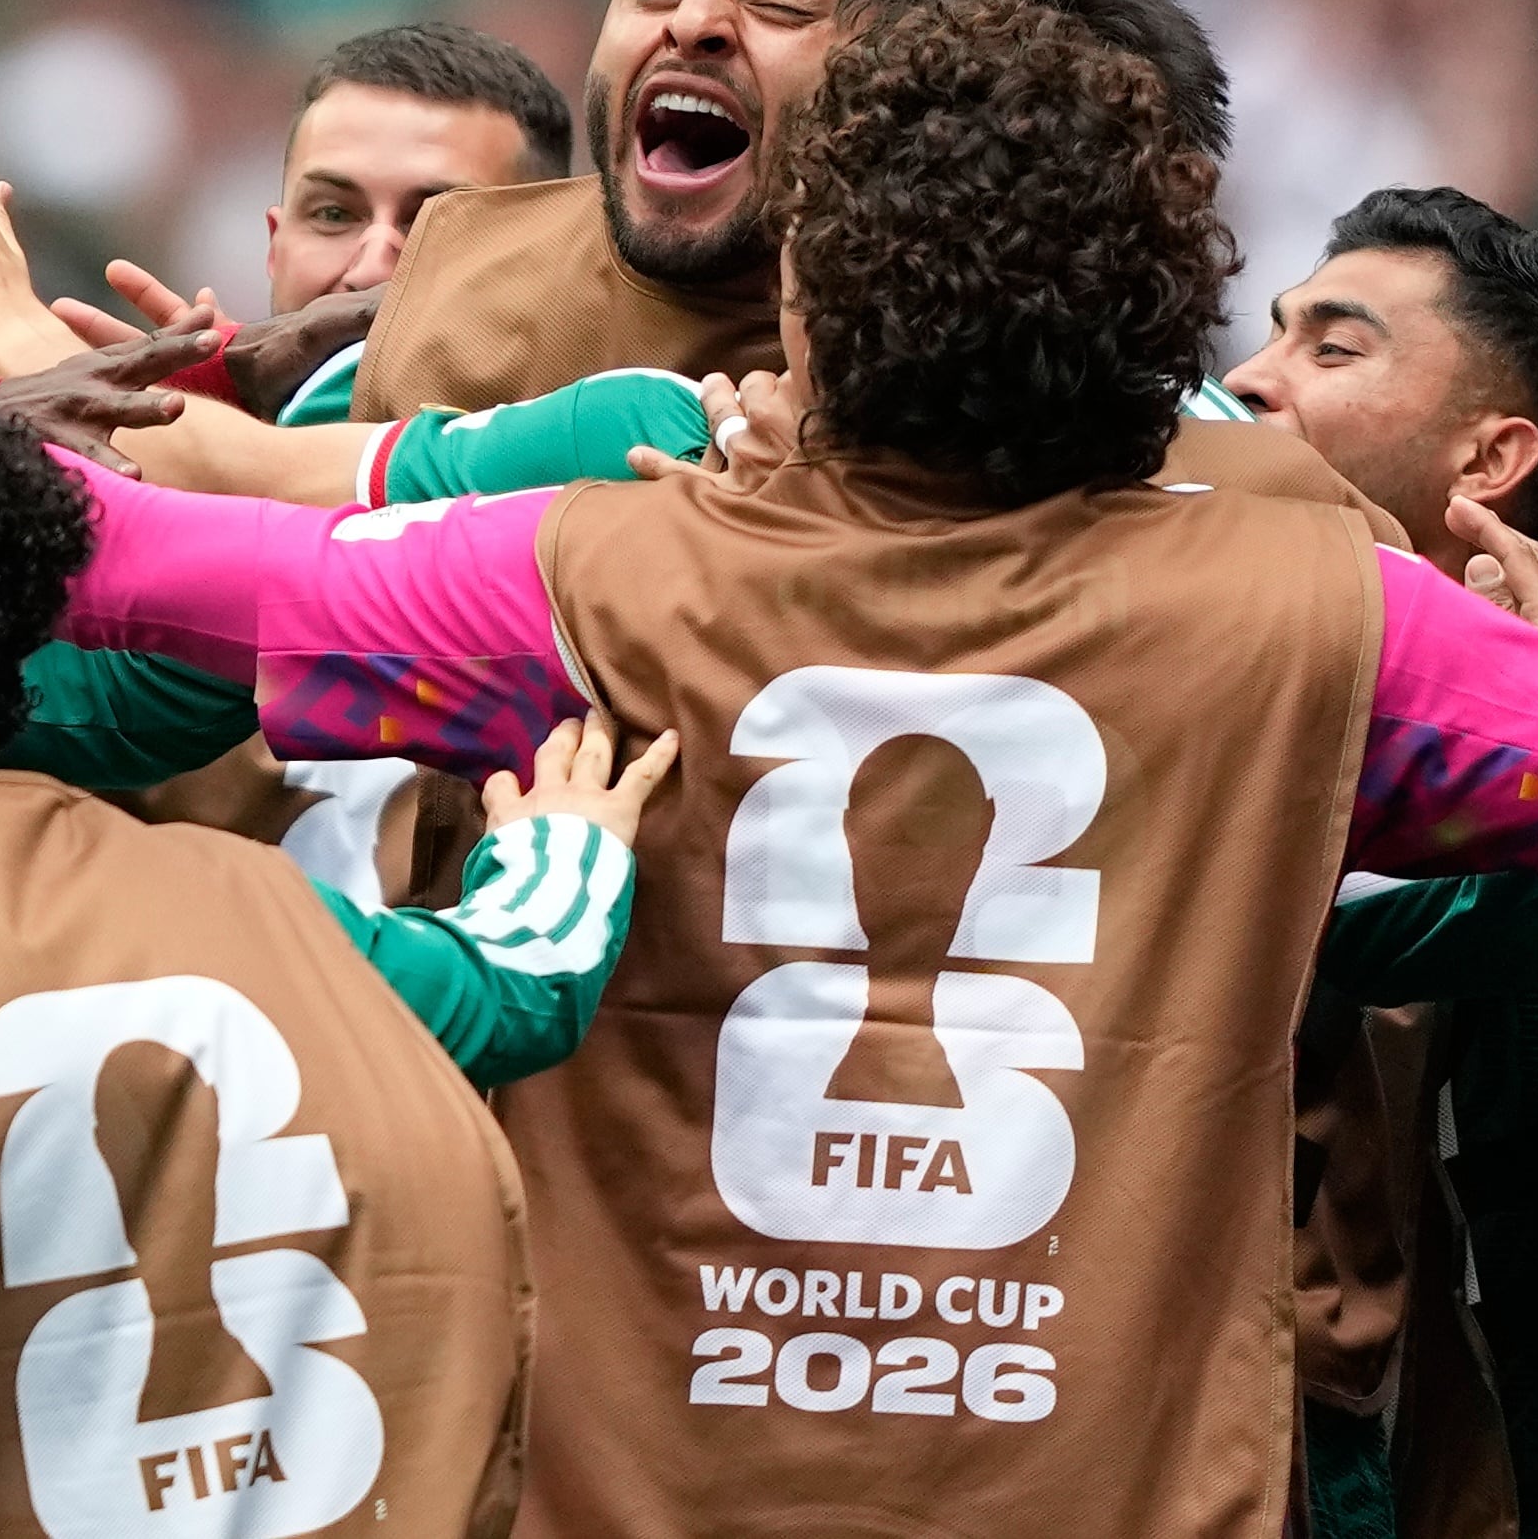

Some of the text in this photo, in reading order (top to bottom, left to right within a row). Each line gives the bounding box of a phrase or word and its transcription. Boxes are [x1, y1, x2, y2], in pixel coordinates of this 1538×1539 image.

[810, 1131, 973, 1195] FIFA
[698, 1263, 1065, 1331] WORLD CUP
[687, 1327, 1057, 1424] 2026
[137, 1428, 288, 1512] FIFA
